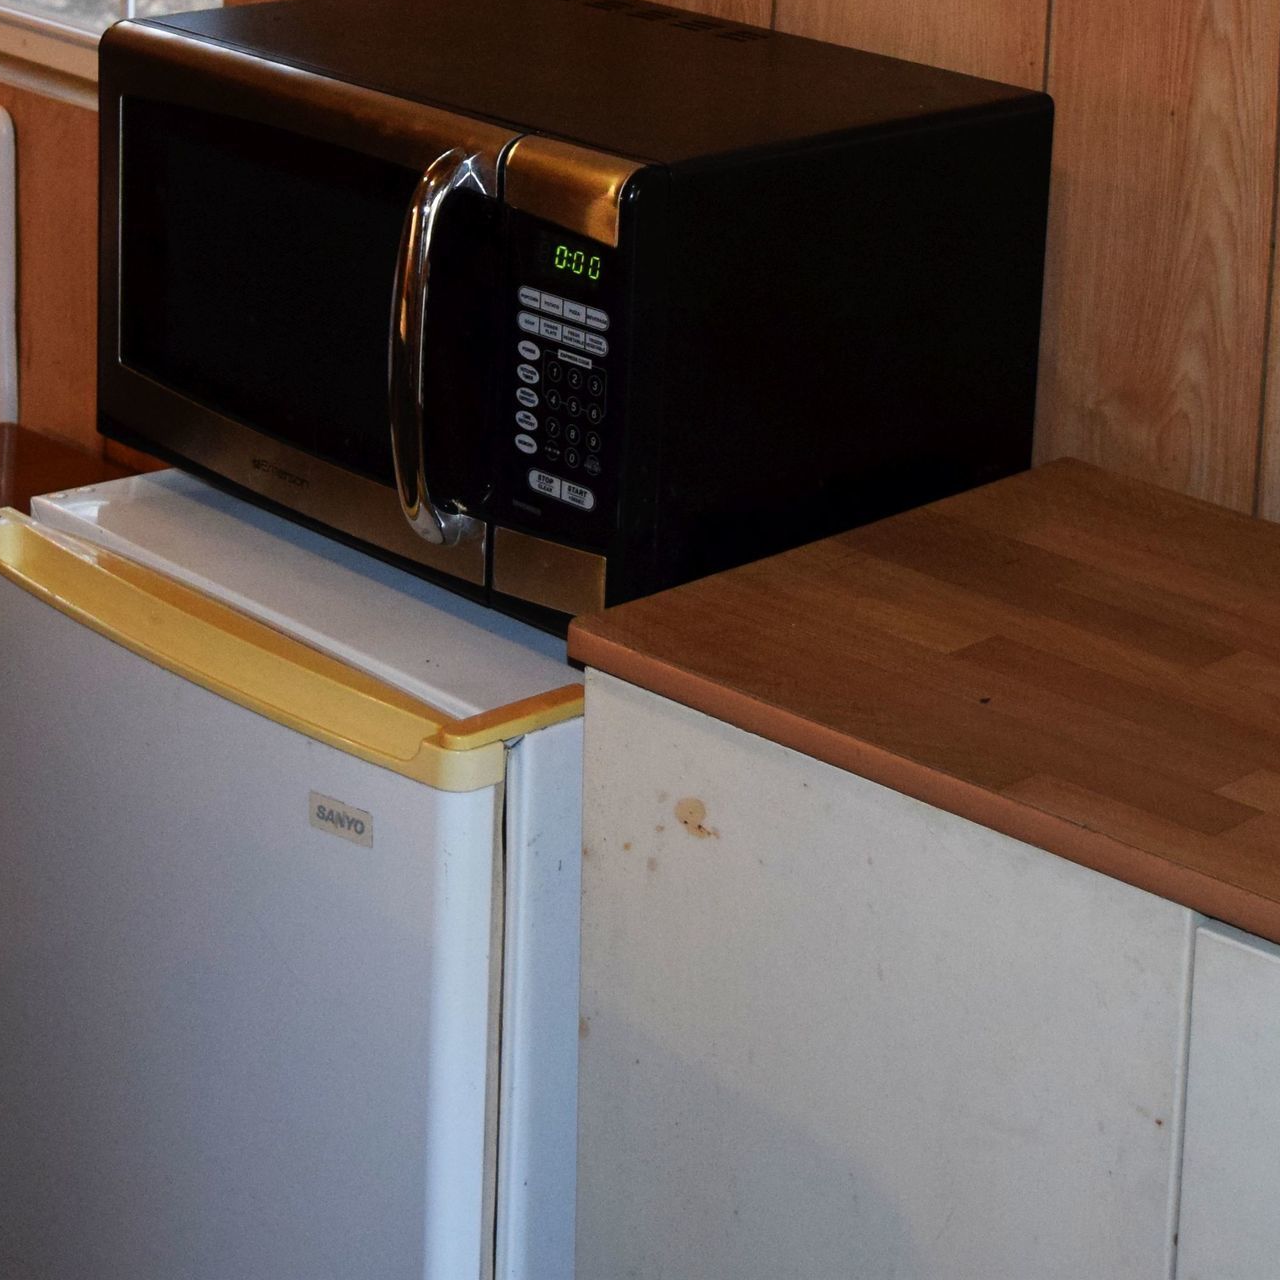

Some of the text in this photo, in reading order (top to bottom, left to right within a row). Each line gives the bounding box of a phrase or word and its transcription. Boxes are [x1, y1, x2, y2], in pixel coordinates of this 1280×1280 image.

[554, 244, 601, 281] 0:00
[537, 473, 554, 485] STOP
[567, 485, 588, 498] START
[315, 804, 366, 836] SANYO
